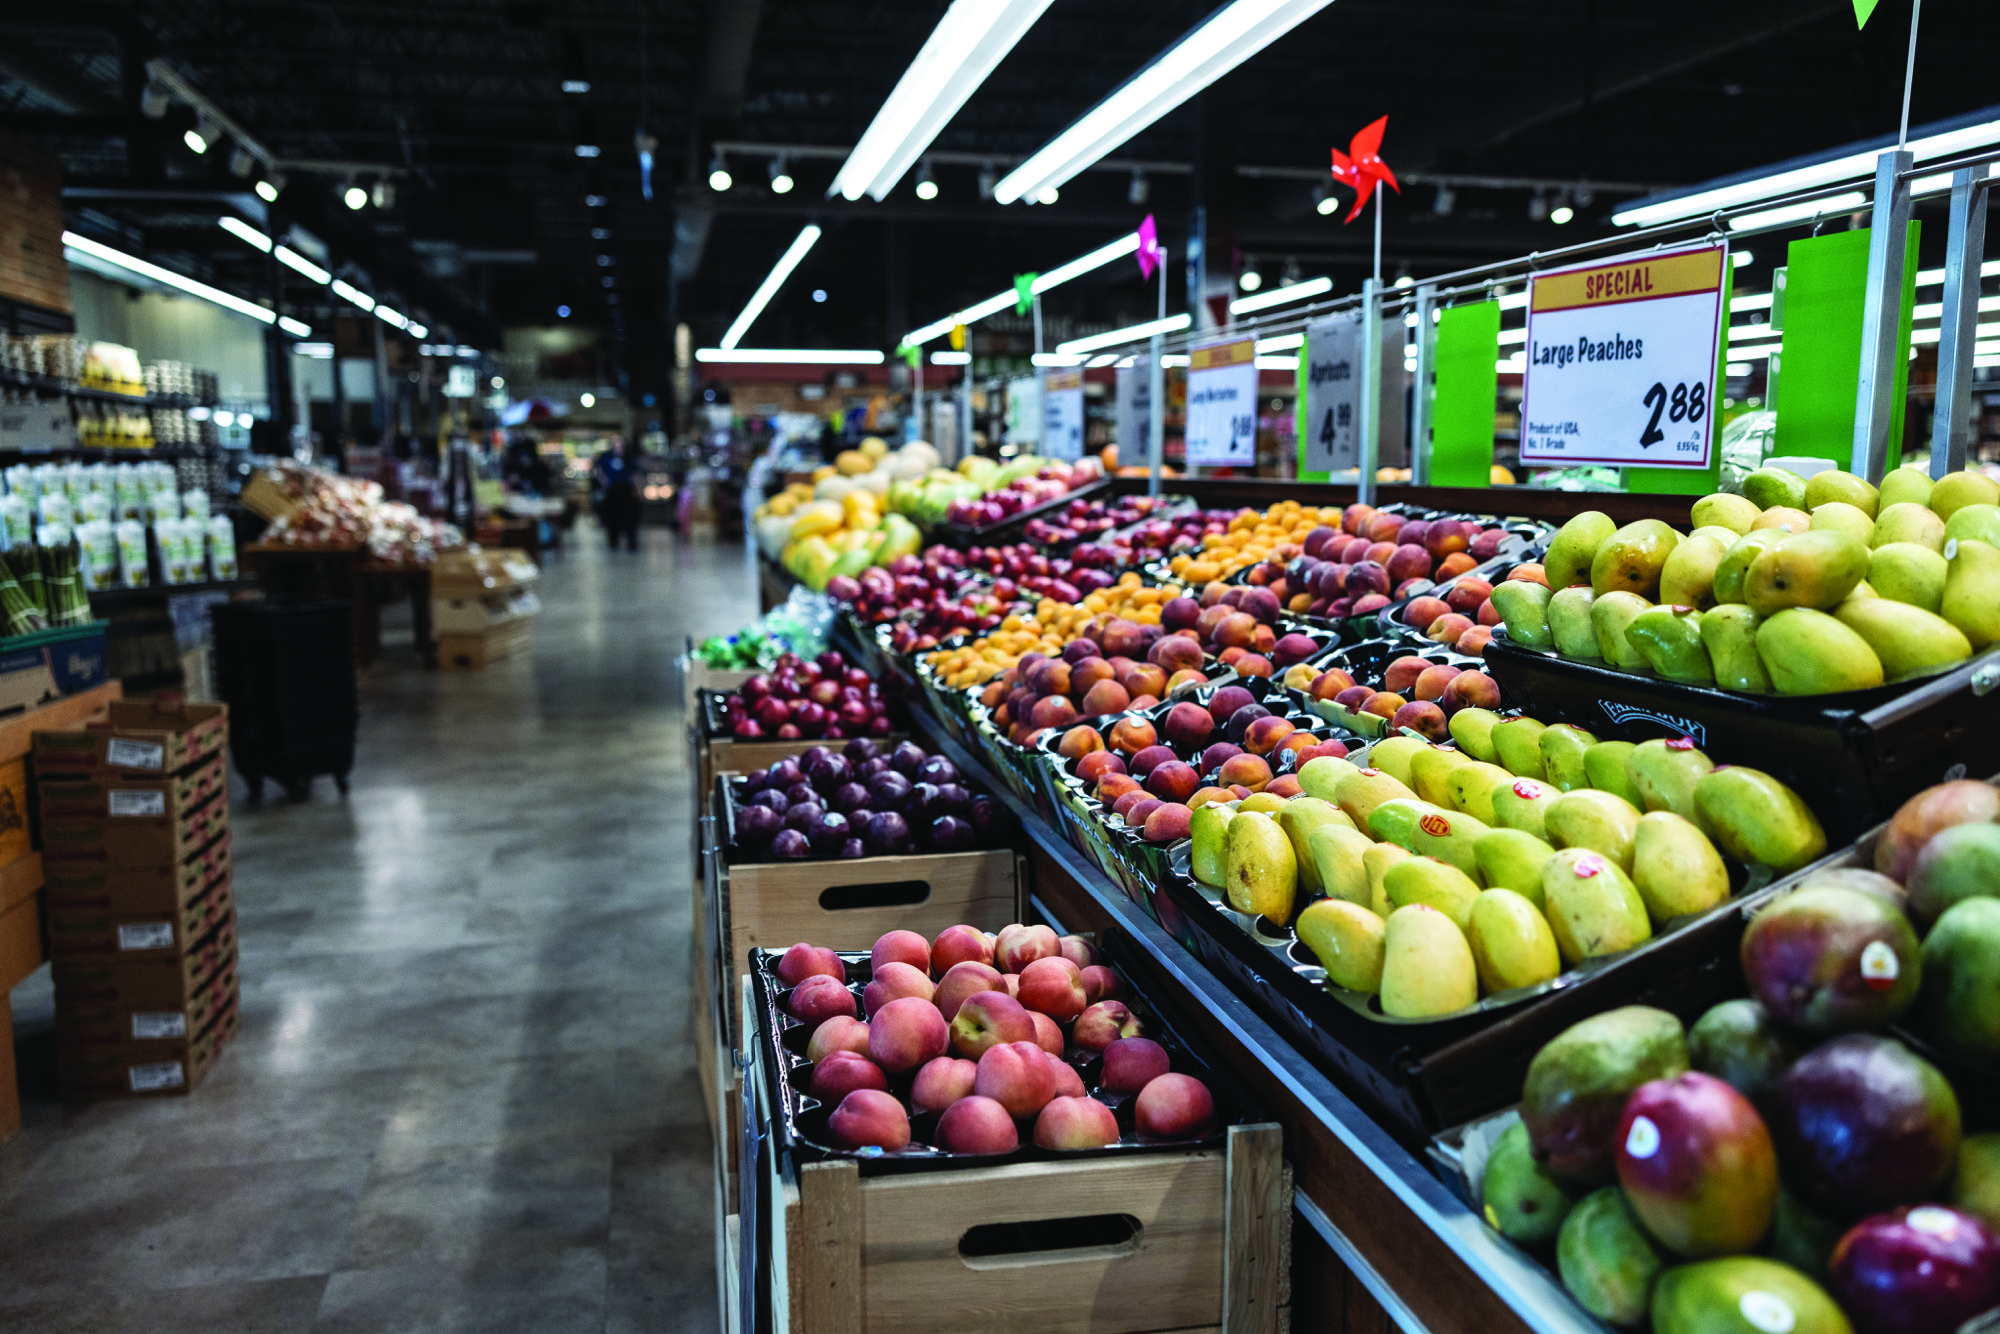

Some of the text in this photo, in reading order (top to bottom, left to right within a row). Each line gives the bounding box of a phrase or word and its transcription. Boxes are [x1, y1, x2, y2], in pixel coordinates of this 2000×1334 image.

[1586, 266, 1653, 300] SPECIAL
[1533, 332, 1643, 369] Large Peaches
[1529, 421, 1553, 434] Product
[1555, 421, 1562, 434] of
[1106, 841, 1158, 895] SUN
